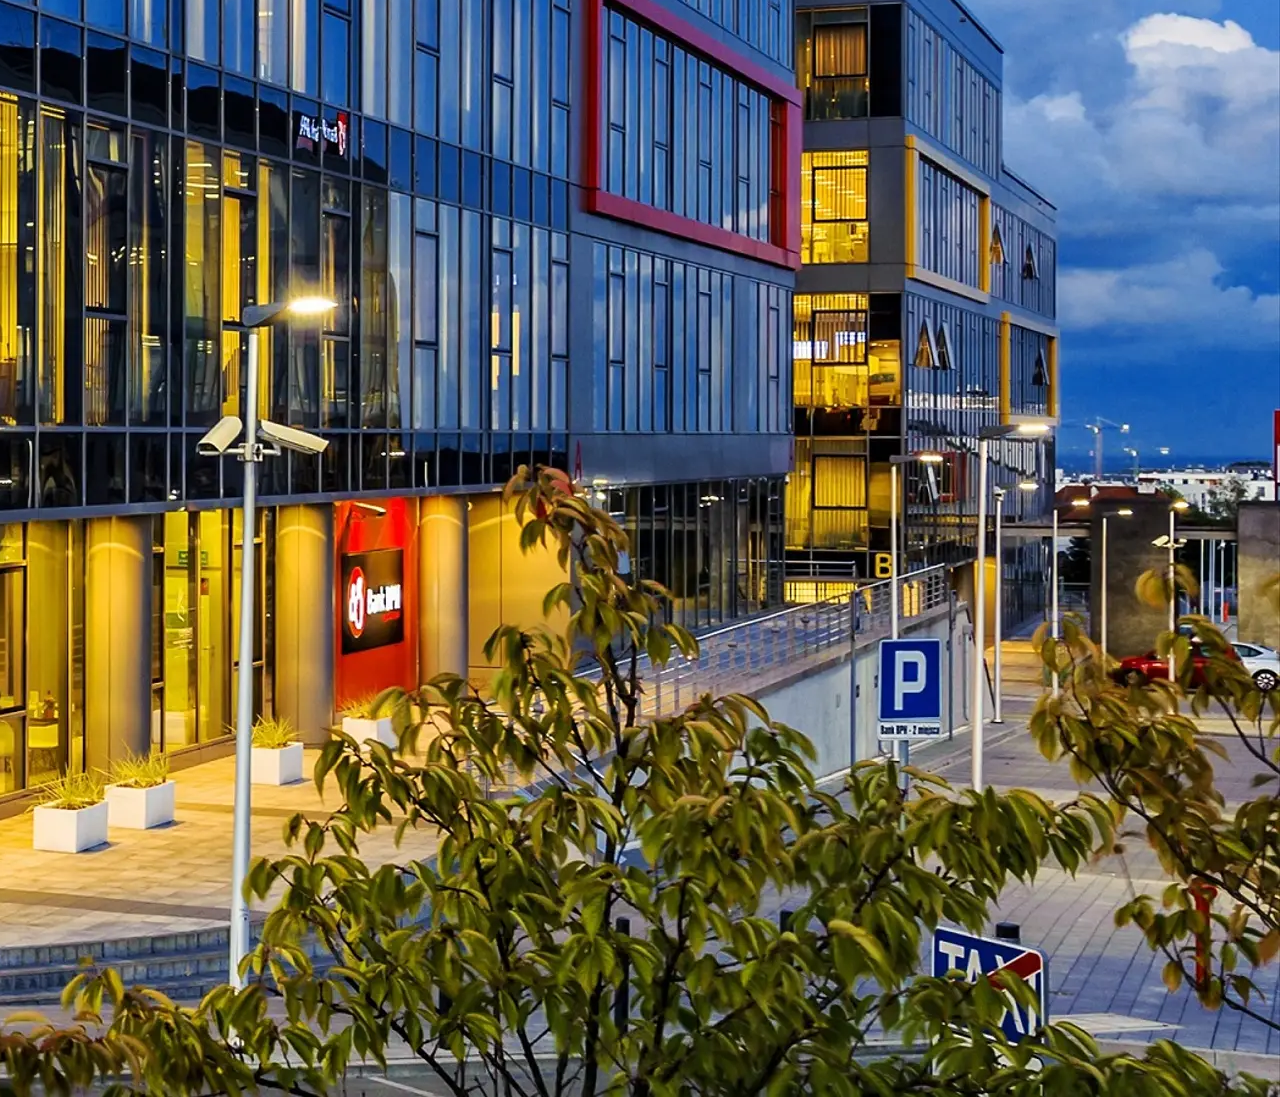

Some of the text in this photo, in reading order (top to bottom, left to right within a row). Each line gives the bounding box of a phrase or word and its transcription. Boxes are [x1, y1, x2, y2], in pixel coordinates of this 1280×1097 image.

[875, 553, 893, 579] B
[894, 650, 927, 711] P
[880, 725, 895, 734] Bank
[896, 725, 908, 734] BPH
[912, 725, 917, 735] 2
